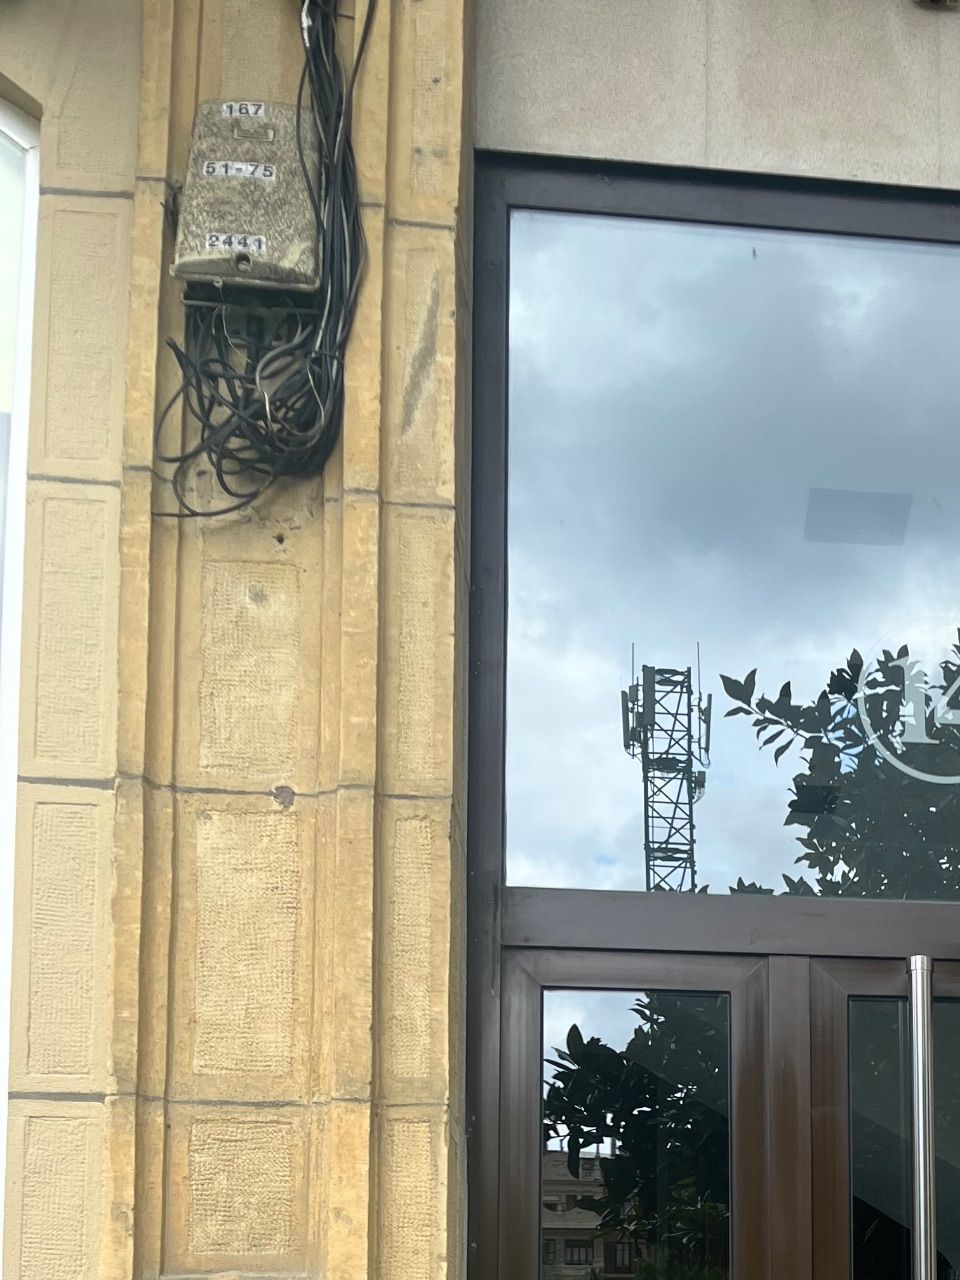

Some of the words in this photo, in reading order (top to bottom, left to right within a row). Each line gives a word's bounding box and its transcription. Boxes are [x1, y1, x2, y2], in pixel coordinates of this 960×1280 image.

[226, 103, 263, 116] 167
[205, 162, 274, 178] 51-75
[208, 234, 262, 250] 2441
